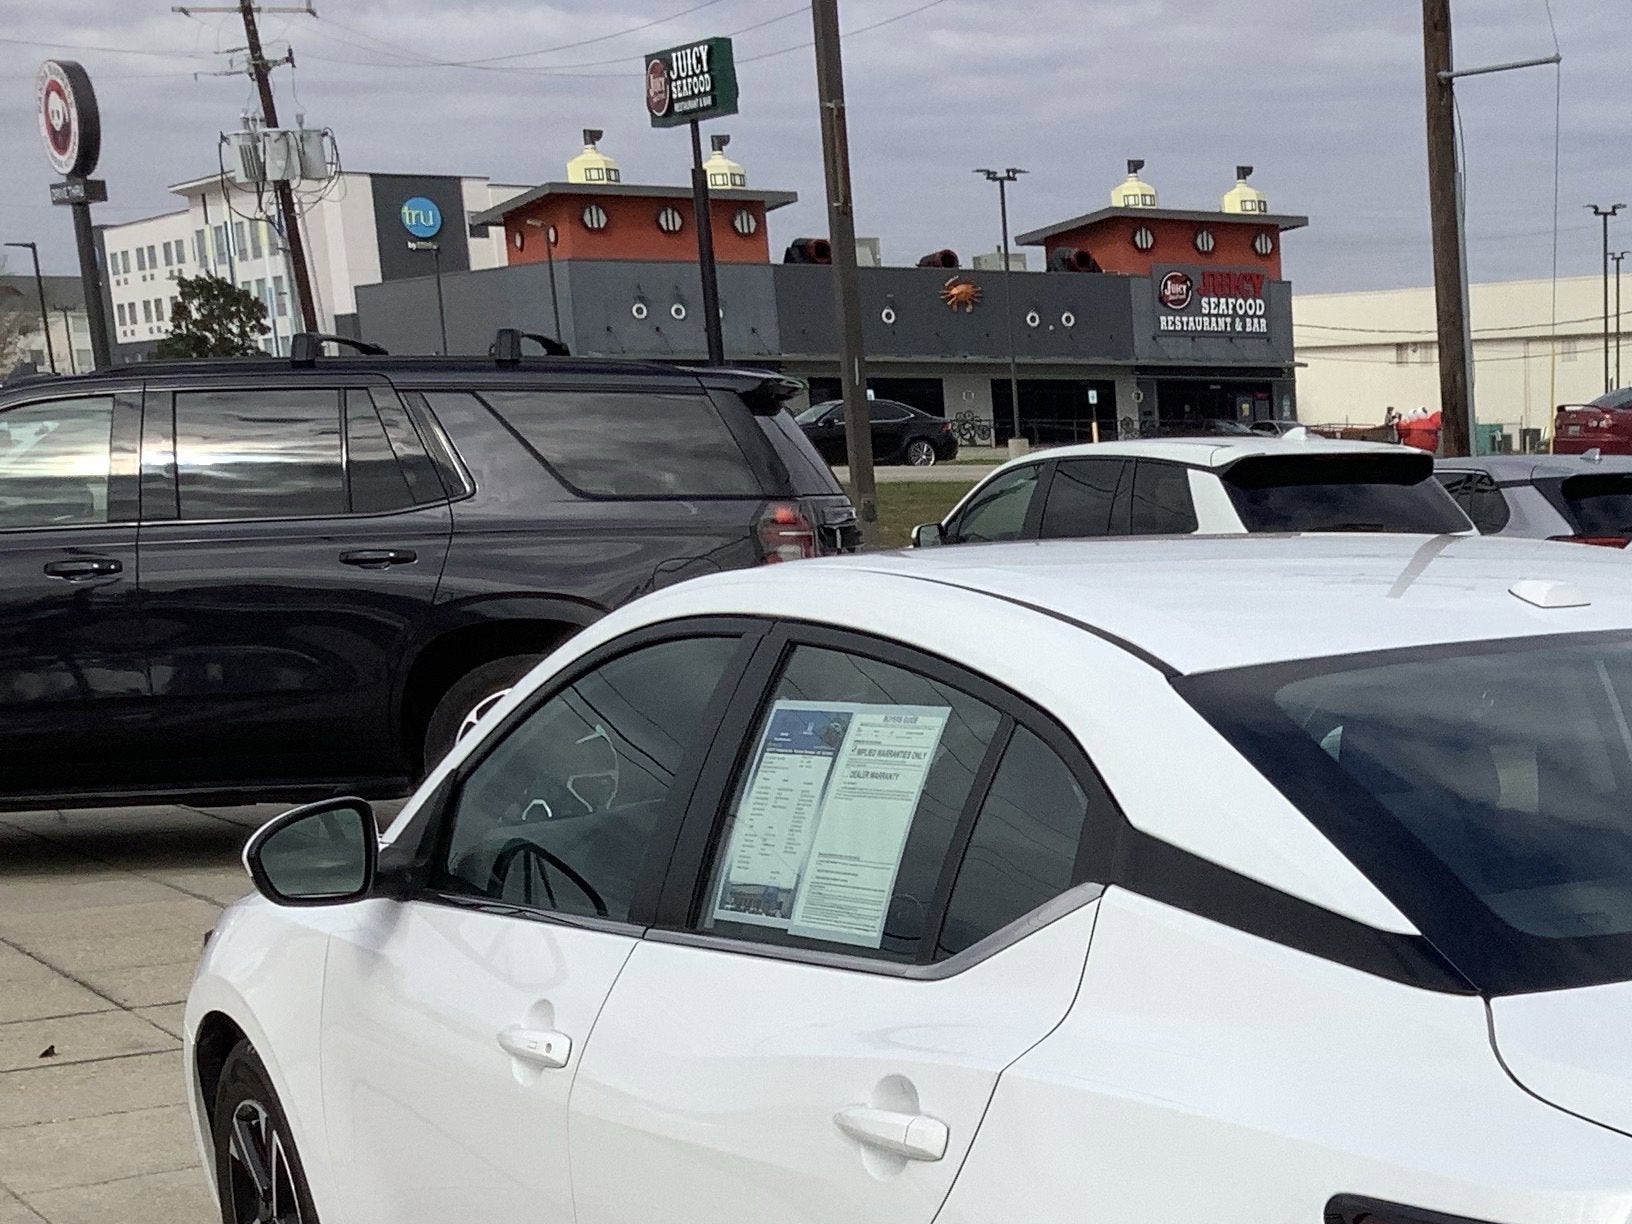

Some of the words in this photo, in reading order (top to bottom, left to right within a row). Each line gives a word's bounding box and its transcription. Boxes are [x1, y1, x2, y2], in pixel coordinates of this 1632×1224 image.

[670, 45, 708, 80] JUICY
[671, 73, 711, 99] SEAFOOD
[402, 205, 434, 227] tru
[1197, 270, 1265, 298] JUICY
[1201, 297, 1265, 316] SEAFOOD
[1160, 315, 1232, 331] RESTAURANT
[1235, 318, 1243, 332] &
[1246, 317, 1267, 333] BAR
